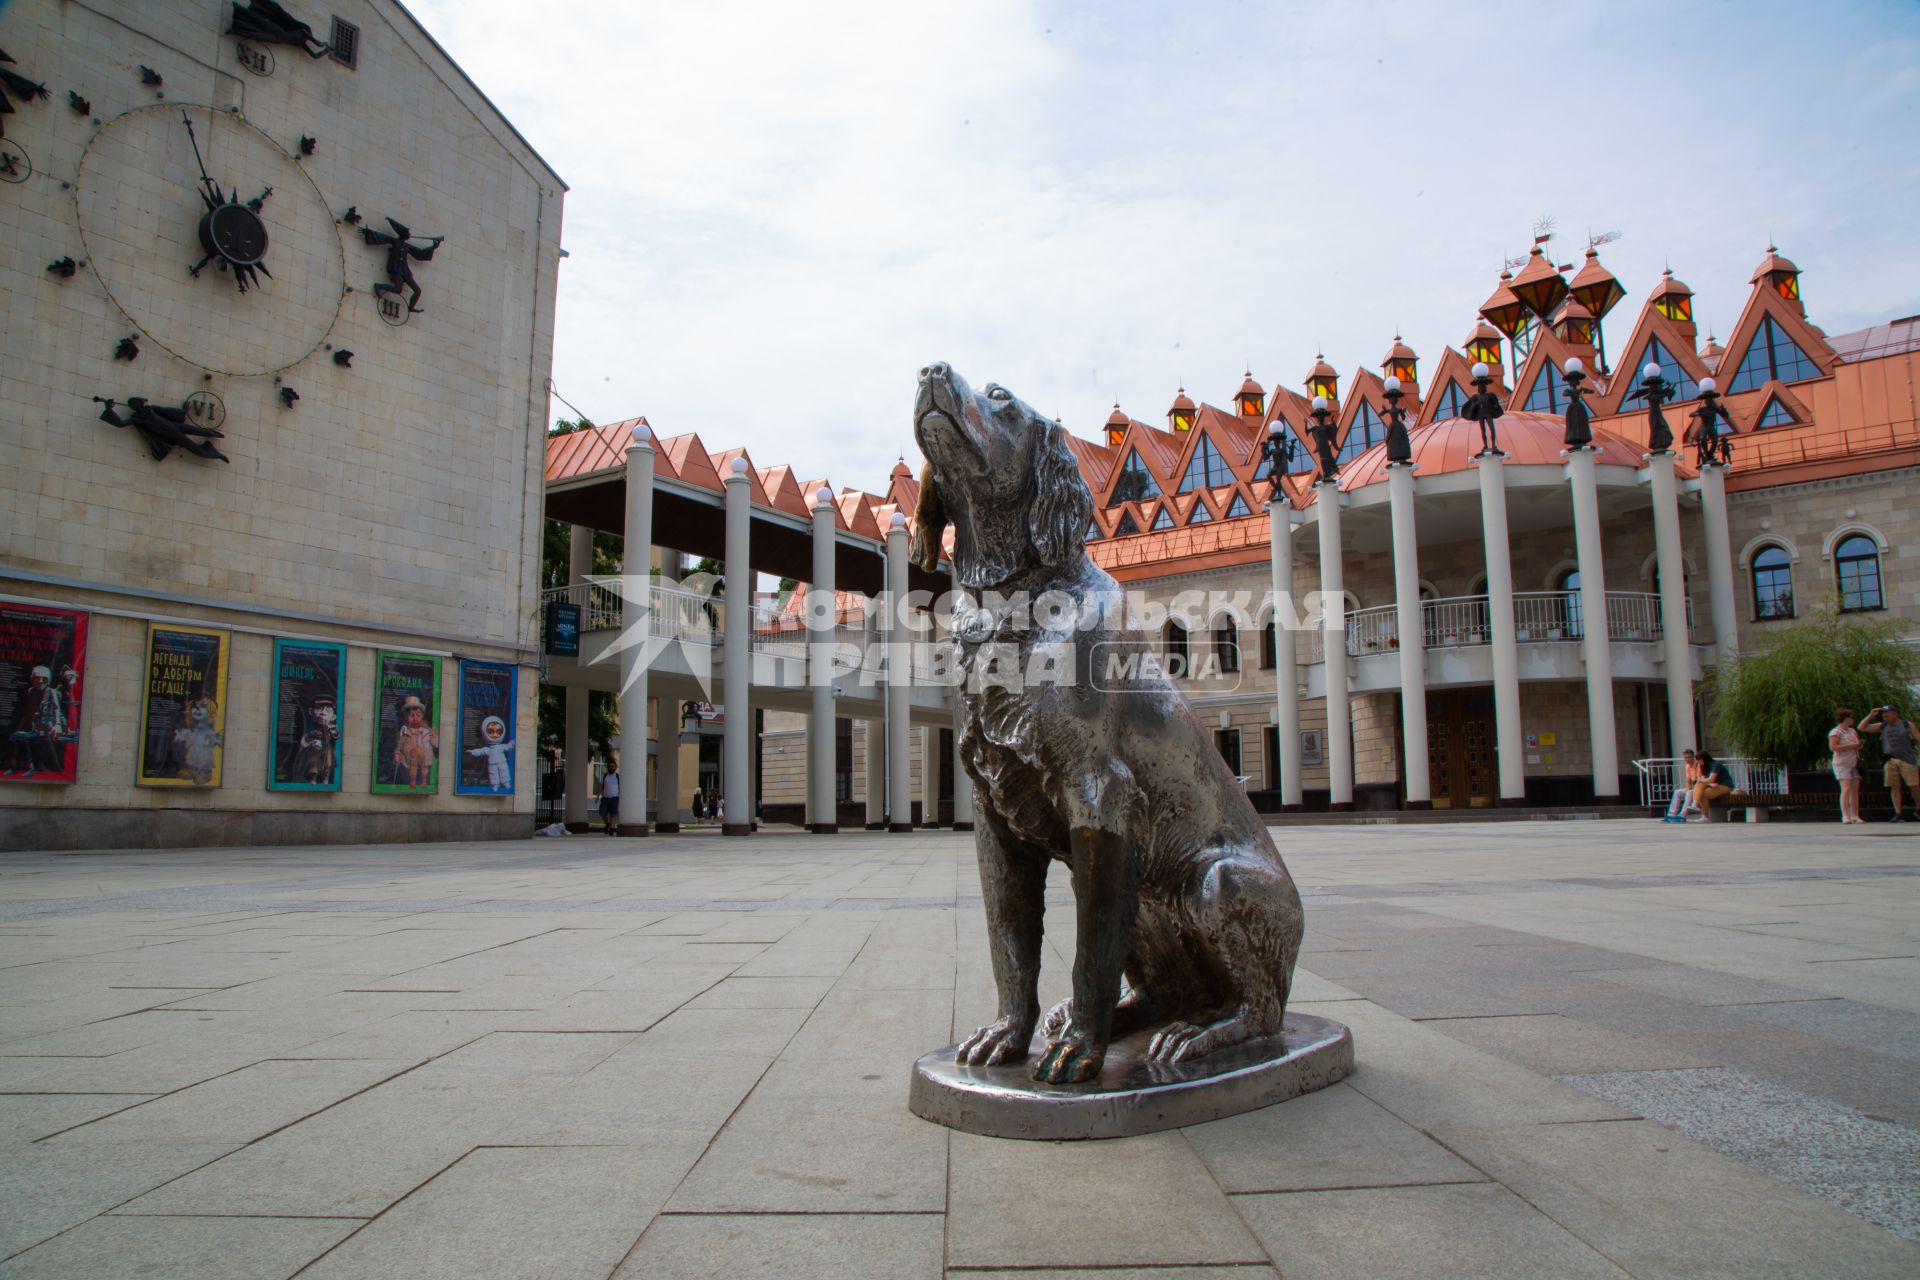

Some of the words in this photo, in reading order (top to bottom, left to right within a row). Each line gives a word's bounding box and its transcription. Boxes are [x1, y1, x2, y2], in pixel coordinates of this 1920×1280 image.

[382, 298, 400, 318] III
[193, 400, 216, 420] VI
[152, 652, 190, 667] ЛЕГЕНДА
[153, 666, 159, 679] О
[163, 667, 202, 681] ДОБРОМ
